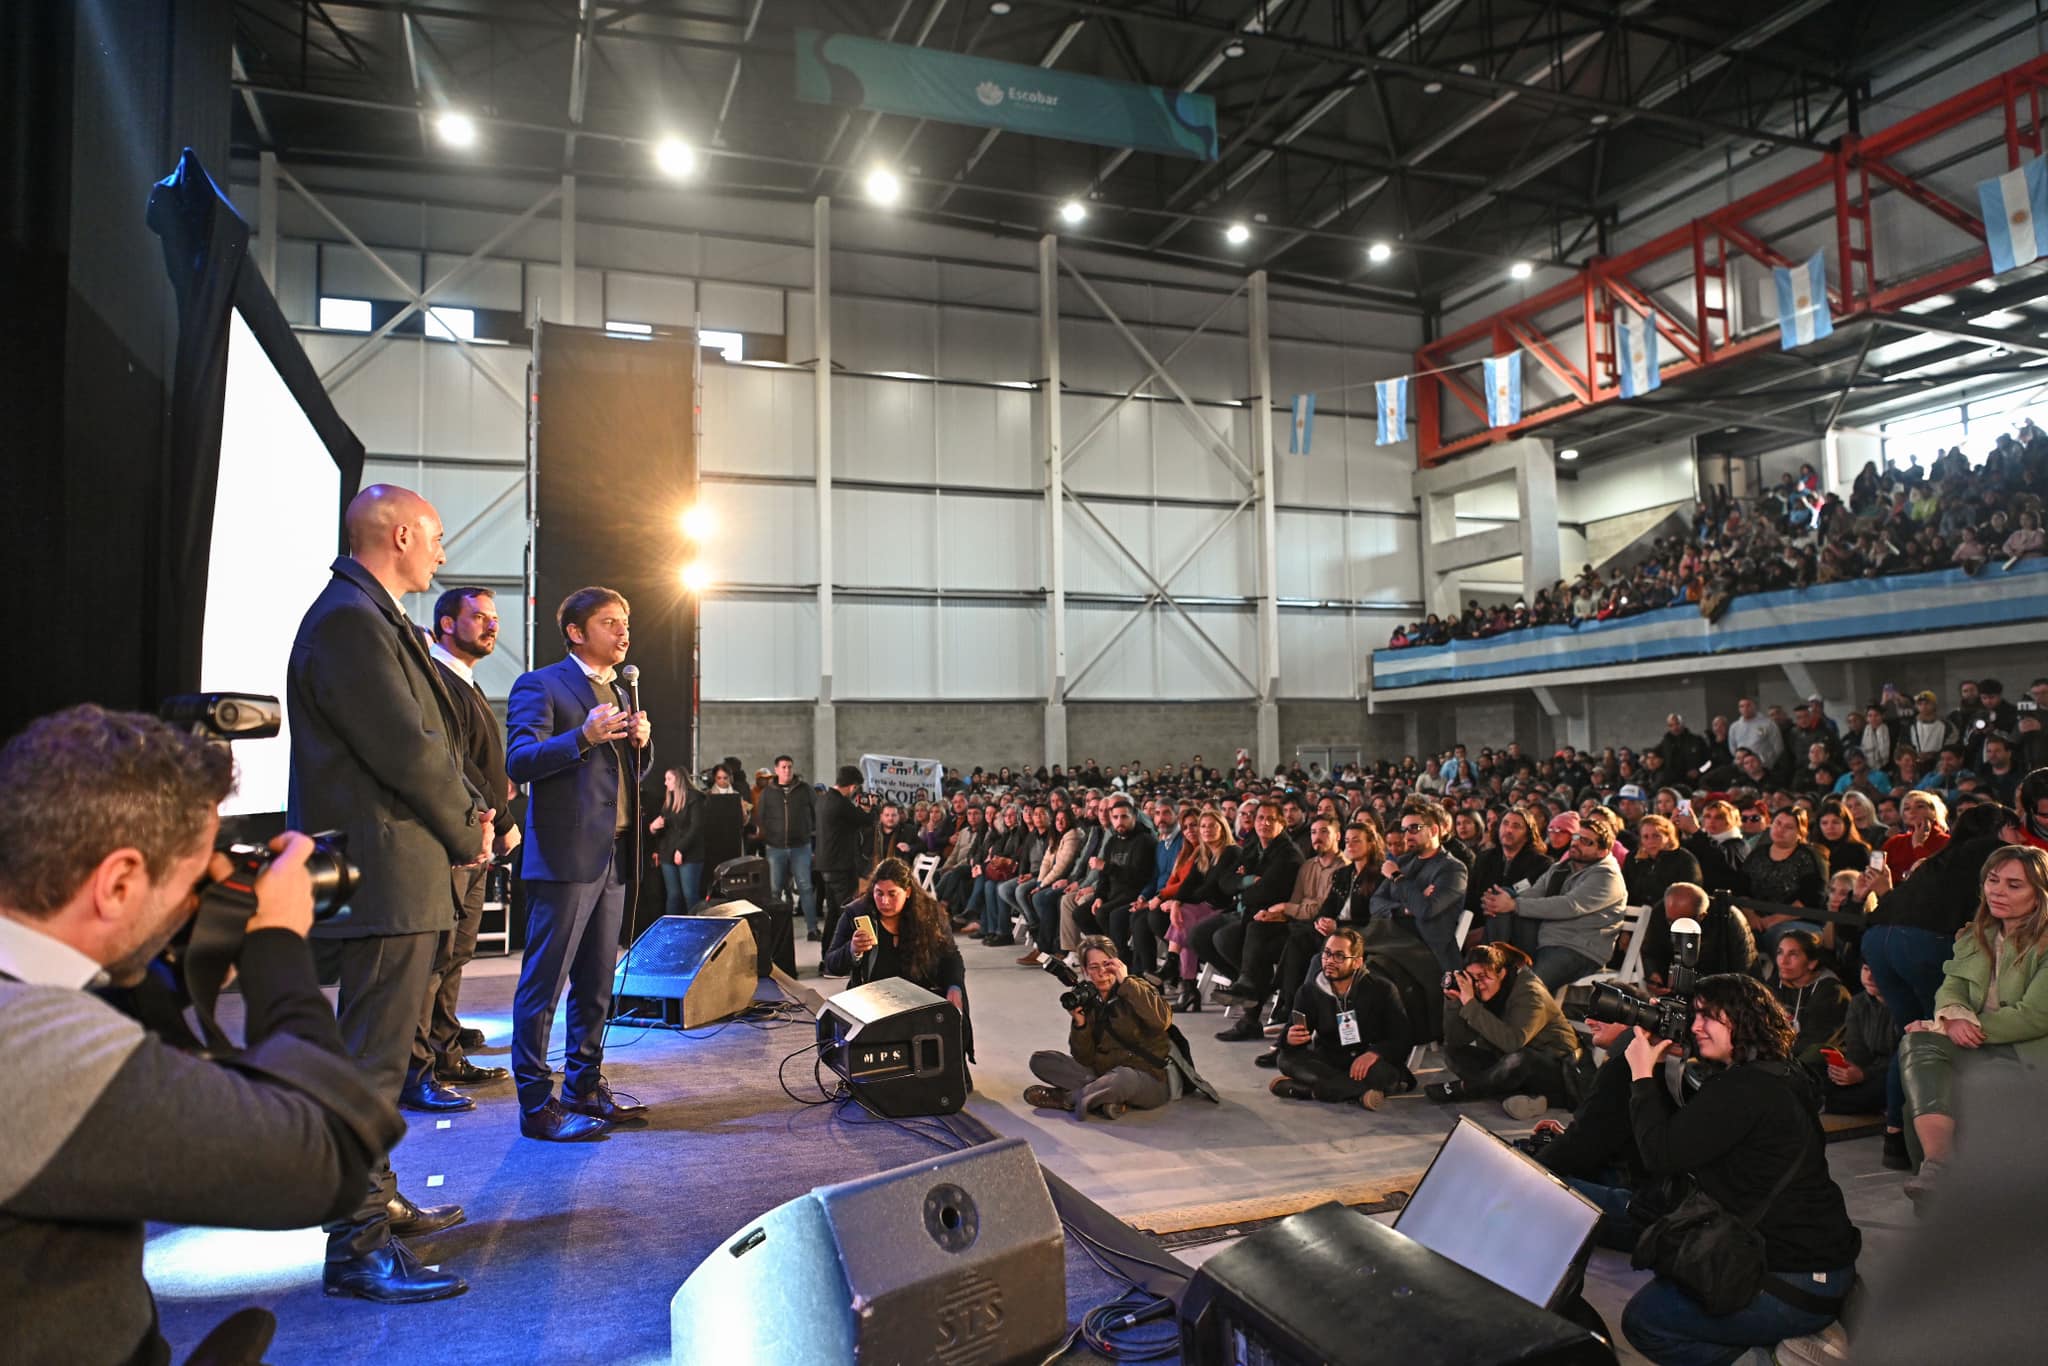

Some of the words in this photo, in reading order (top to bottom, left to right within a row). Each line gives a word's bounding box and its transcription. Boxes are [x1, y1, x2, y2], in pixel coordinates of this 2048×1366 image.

[1008, 87, 1058, 106] Escobar
[892, 759, 904, 767] La
[936, 1298, 1004, 1344] STS
